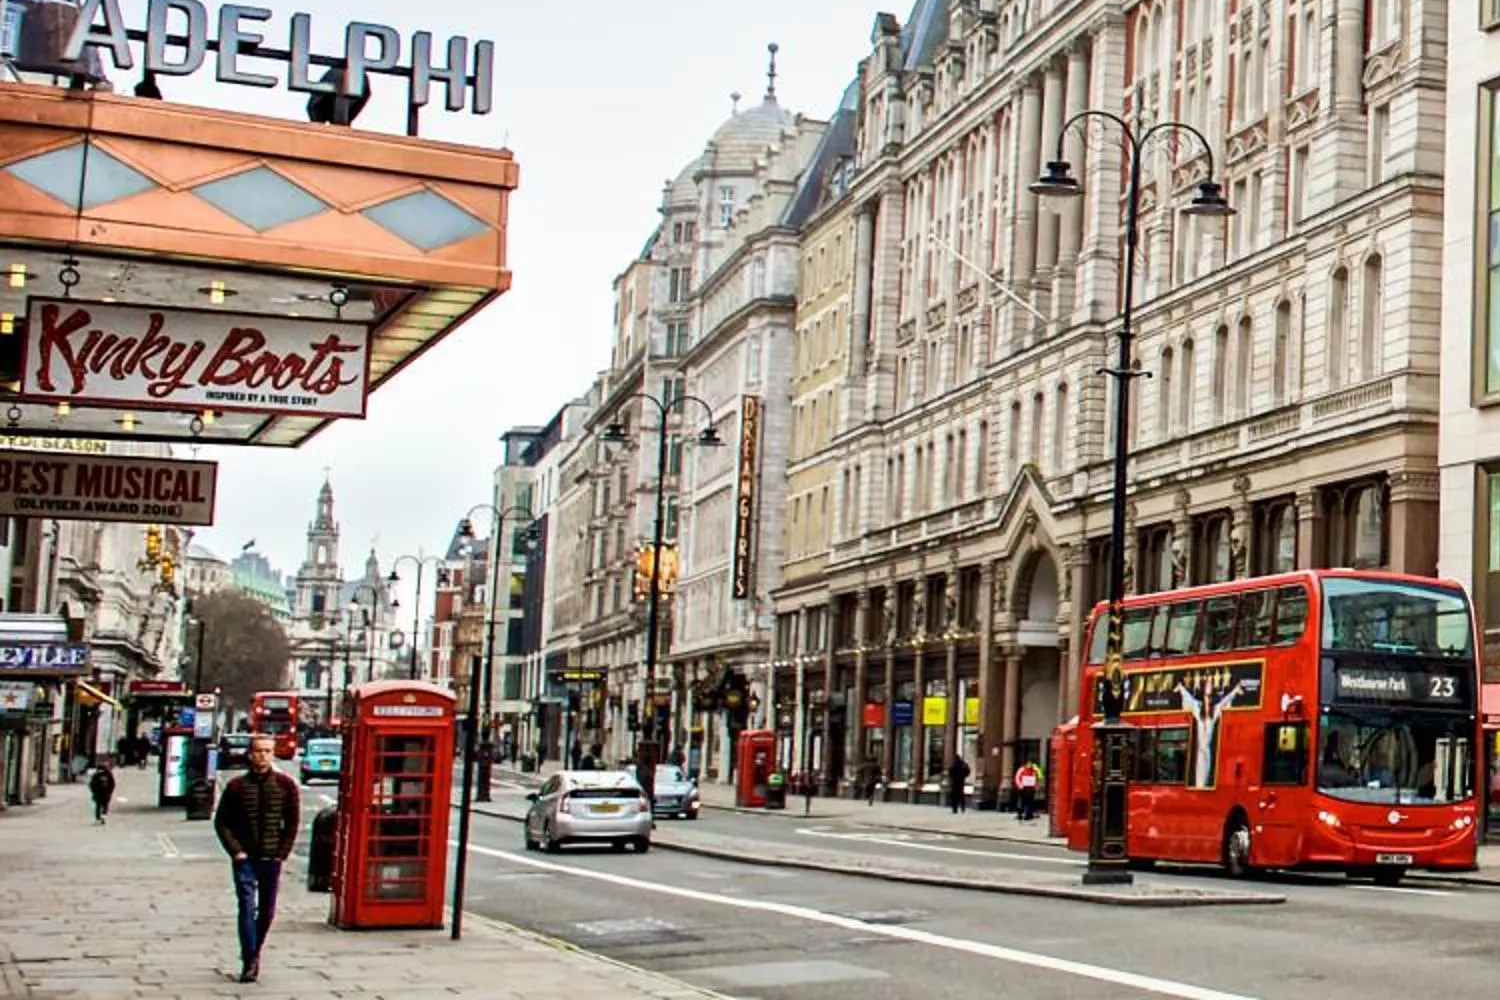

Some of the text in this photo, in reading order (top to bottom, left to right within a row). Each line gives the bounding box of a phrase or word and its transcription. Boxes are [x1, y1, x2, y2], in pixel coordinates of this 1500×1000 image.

[36, 303, 361, 397] Kinky Boots
[205, 391, 246, 401] INSPIRED
[248, 393, 259, 402] BY
[269, 395, 289, 404] TRUE
[291, 396, 318, 406] STORY
[0, 461, 205, 503] BEST MUSICAL
[84, 501, 139, 515] AWARD
[1430, 677, 1456, 697] 23
